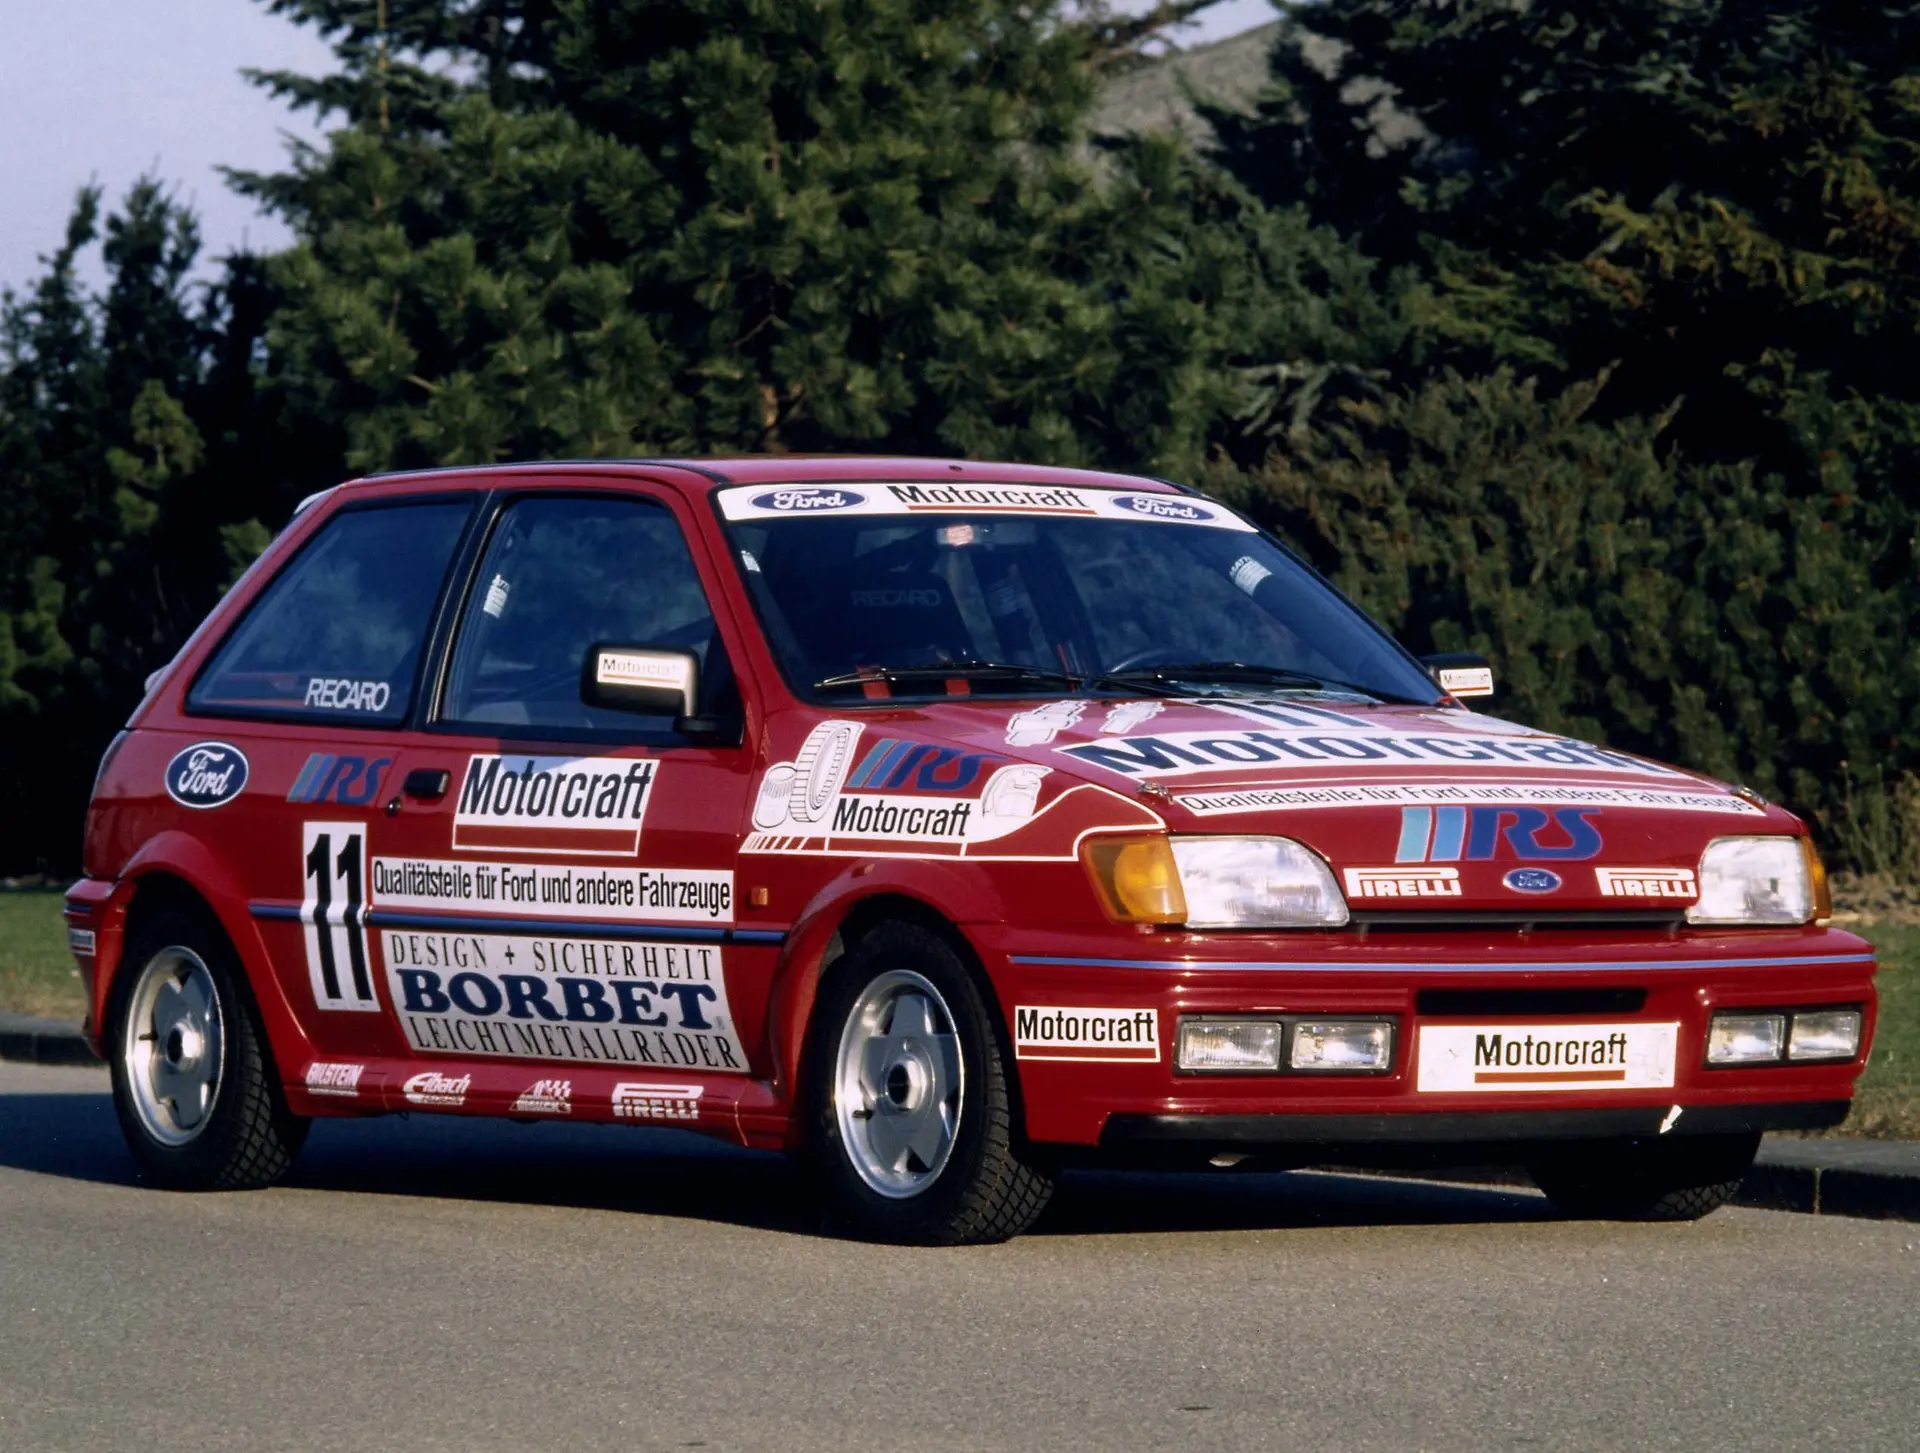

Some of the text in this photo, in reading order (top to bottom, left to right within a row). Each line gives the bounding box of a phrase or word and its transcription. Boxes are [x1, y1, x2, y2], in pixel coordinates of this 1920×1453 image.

[773, 489, 846, 510] Ford
[887, 485, 1090, 509] Motorcraft
[1131, 497, 1199, 520] Ford
[602, 658, 680, 678] Motorcraf
[304, 677, 390, 712] RECARO
[177, 749, 235, 796] Ford
[887, 743, 1008, 791] RS
[1061, 732, 1676, 774] Motorcraft
[316, 755, 392, 805] RS
[465, 758, 652, 821] Motorcraft
[1180, 789, 1362, 811] Qualitätsteile
[1364, 784, 1399, 800] für
[1401, 785, 1470, 800] Ford
[1470, 785, 1523, 800] und
[1524, 786, 1618, 803] andere
[832, 797, 972, 837] Motorcraft
[1466, 806, 1603, 860] RS
[374, 860, 731, 917] Qualitätsteile für Ford und andere Fahrzeuge
[1344, 868, 1462, 897] PIRELLI
[1595, 867, 1698, 898] PIRELLI
[306, 832, 372, 1002] 11
[391, 934, 488, 969] DESIGN
[533, 940, 713, 981] SICHERHEIT
[396, 968, 718, 1030] BORBET
[408, 1016, 742, 1069] LEICHTMETALLRÄDER
[1017, 1007, 1156, 1043] Motorcraft
[1474, 1033, 1627, 1066] Motorcraft
[612, 1082, 704, 1119] PIRELLI
